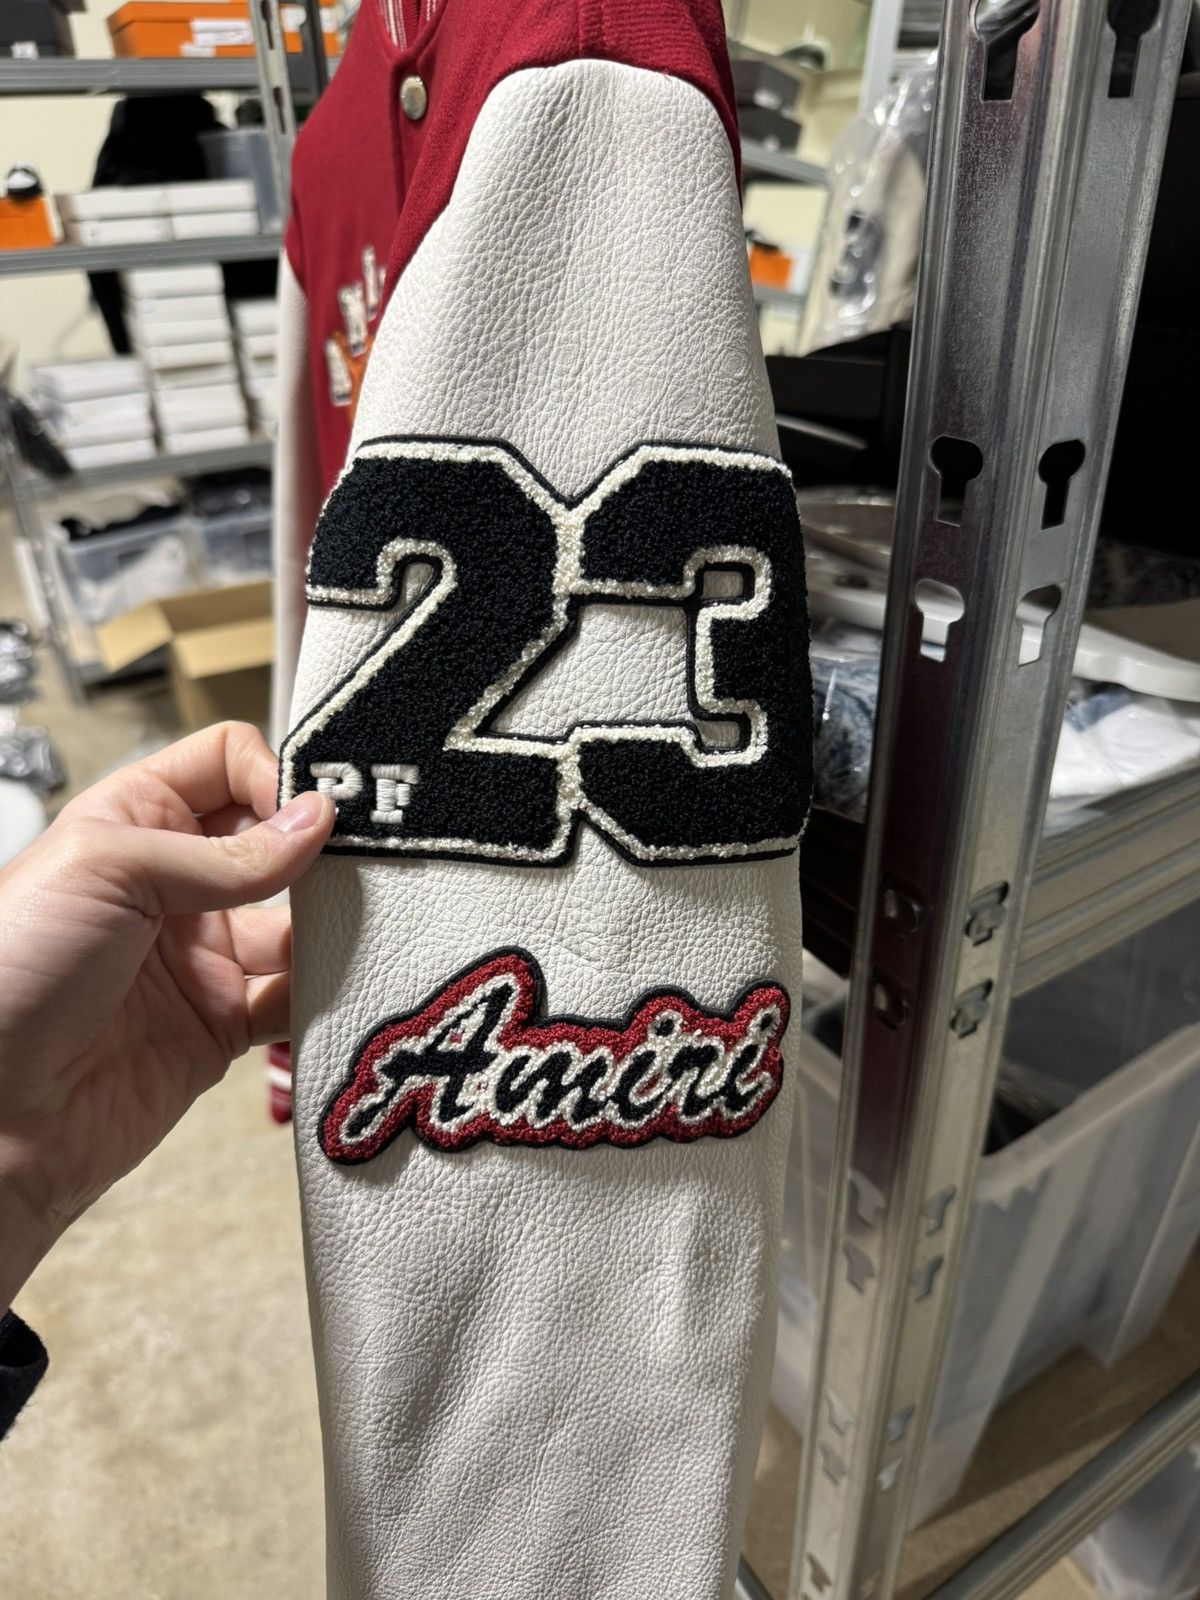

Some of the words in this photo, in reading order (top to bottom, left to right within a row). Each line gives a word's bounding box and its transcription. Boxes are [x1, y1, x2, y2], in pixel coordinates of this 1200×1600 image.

[280, 438, 812, 866] 23
[310, 762, 420, 824] PF
[339, 972, 780, 1146] Amiri
